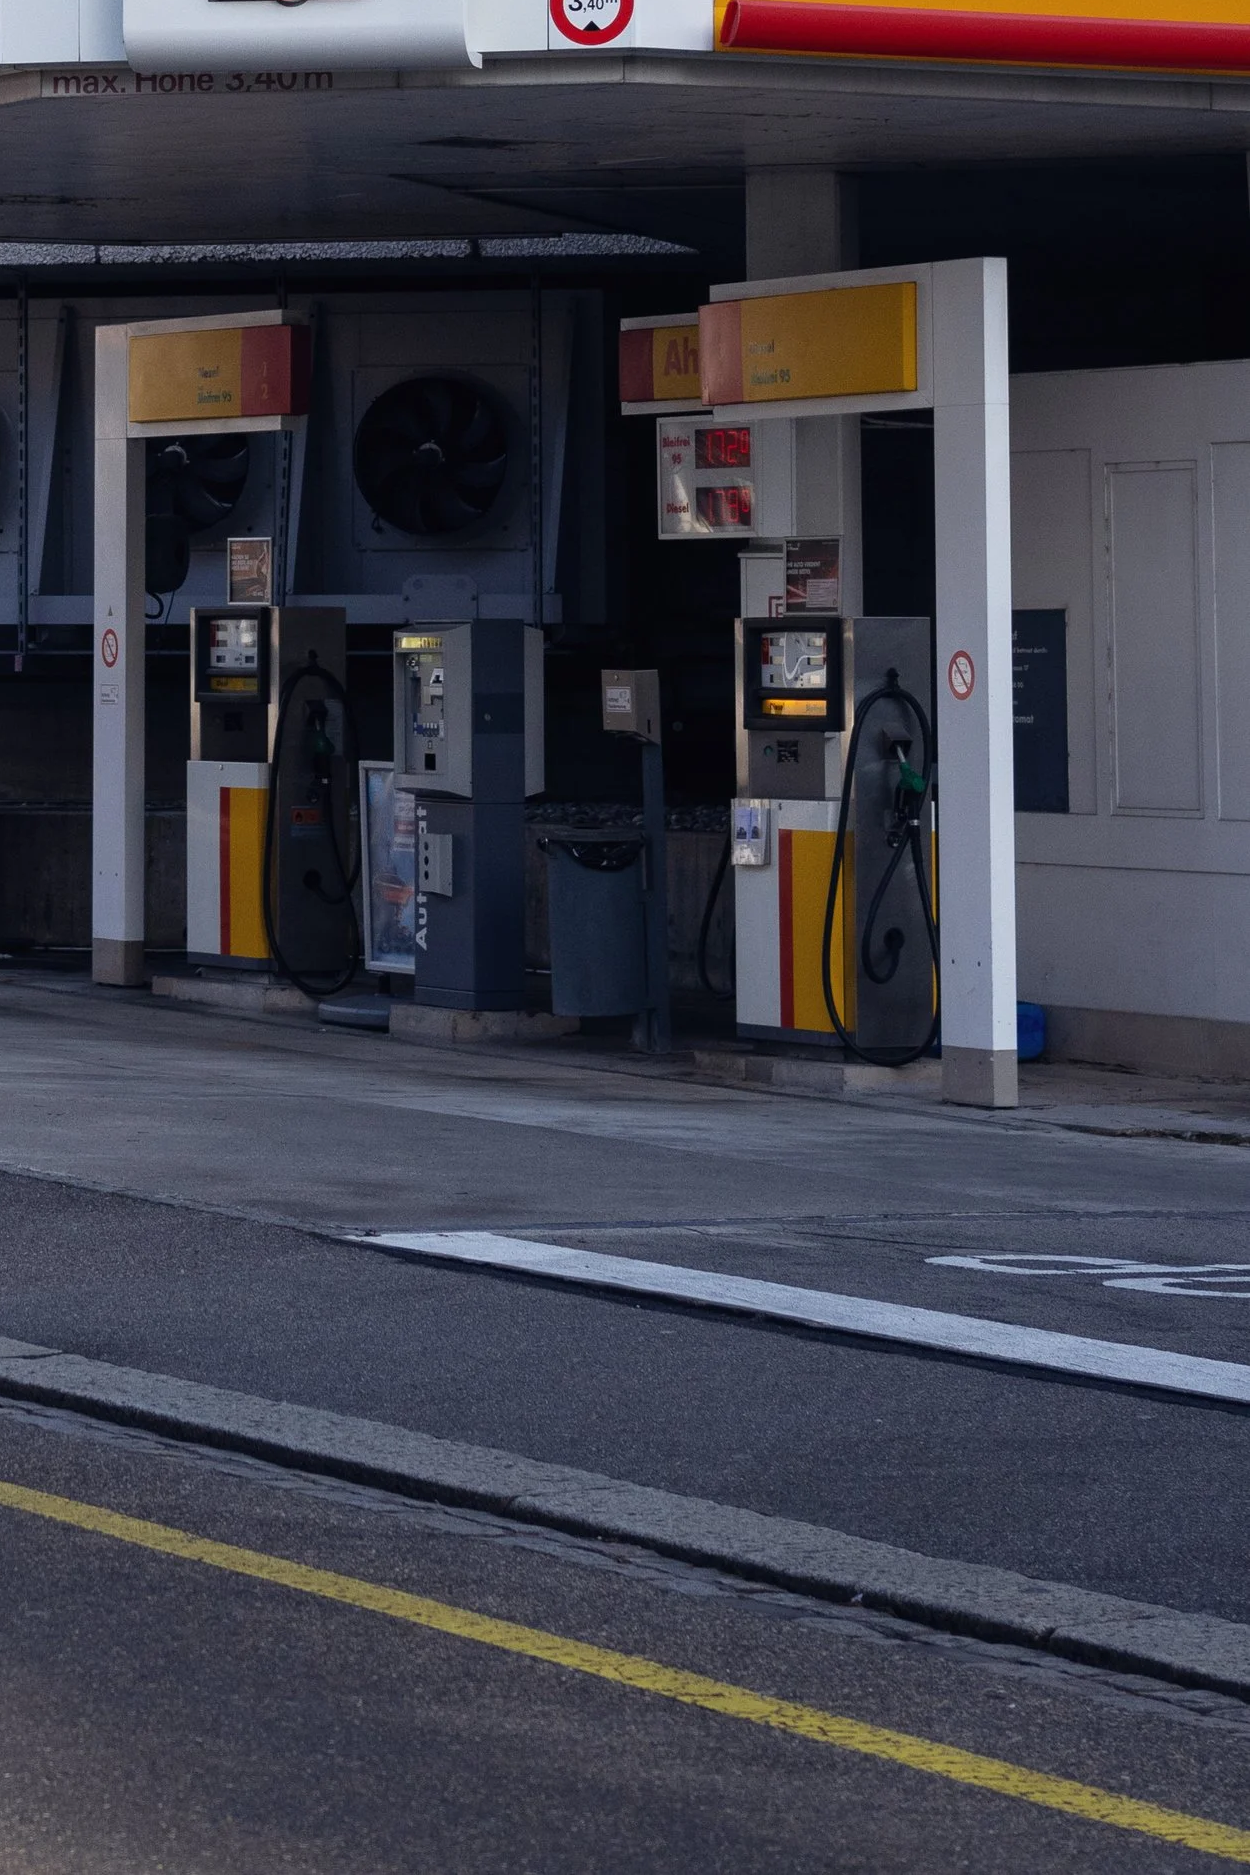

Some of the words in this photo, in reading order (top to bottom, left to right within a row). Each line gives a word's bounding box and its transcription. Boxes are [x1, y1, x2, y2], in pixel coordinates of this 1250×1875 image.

[52, 75, 126, 94] max.
[662, 437, 690, 448] Bleifrei
[672, 453, 682, 464] 95
[666, 503, 689, 514] Diesel
[416, 805, 428, 951] Autat
